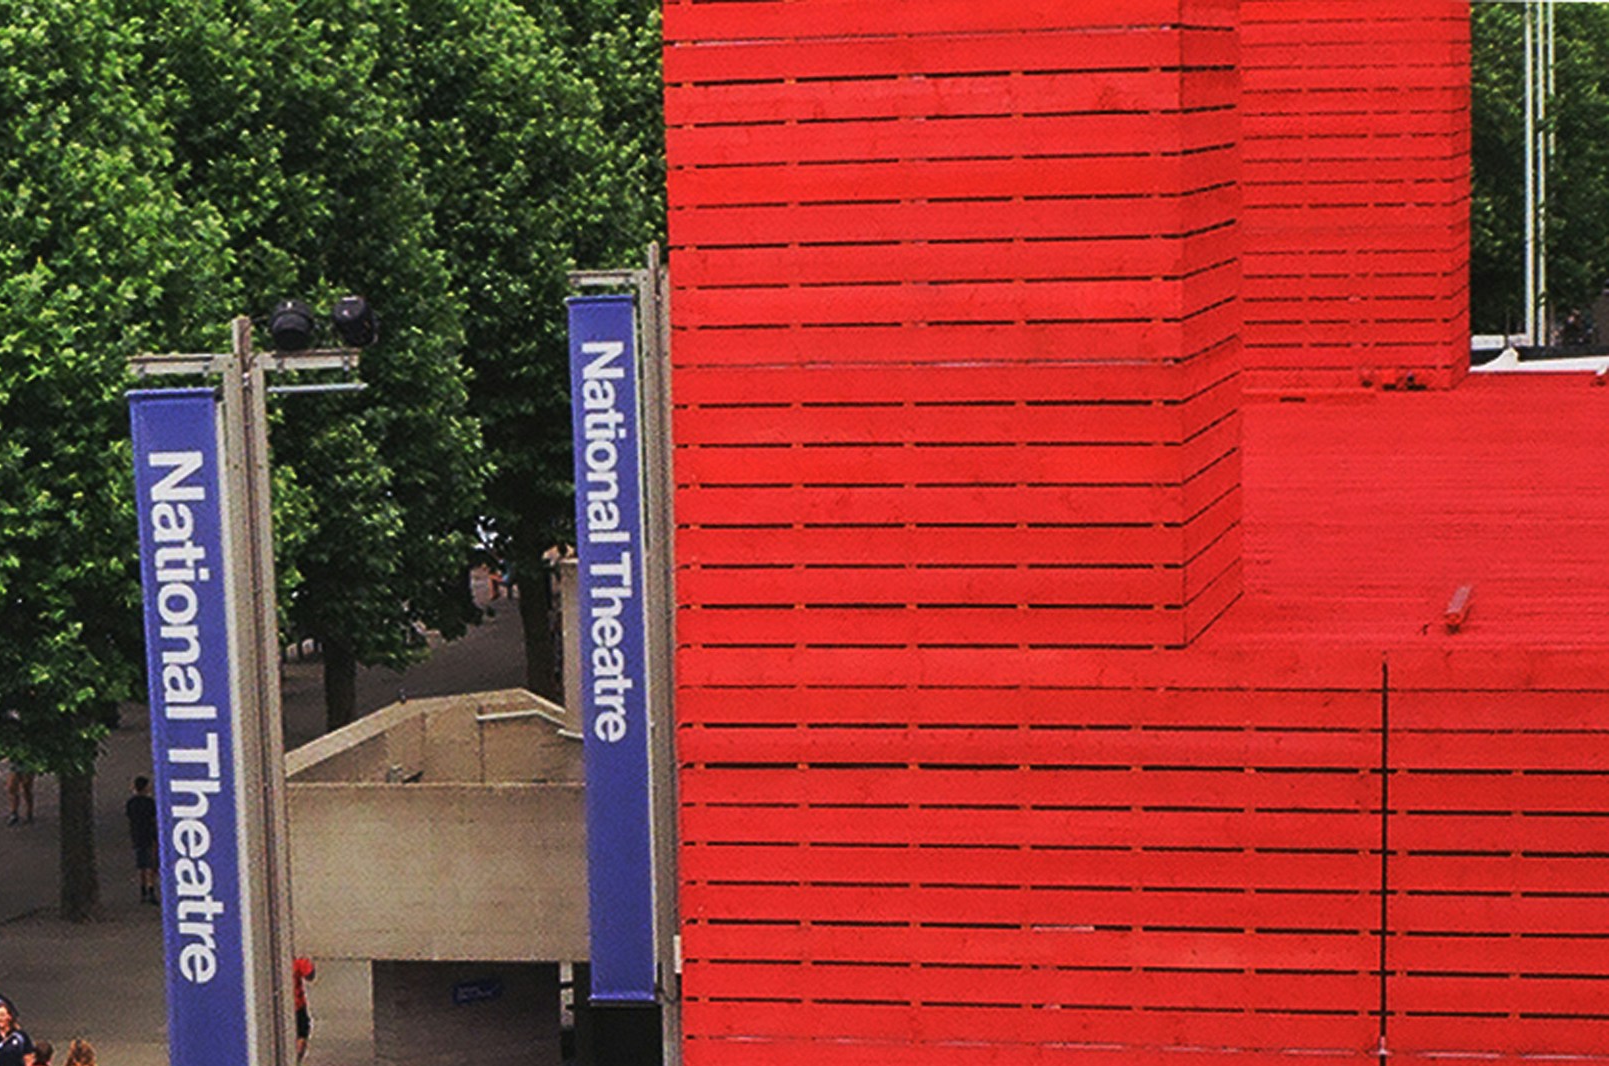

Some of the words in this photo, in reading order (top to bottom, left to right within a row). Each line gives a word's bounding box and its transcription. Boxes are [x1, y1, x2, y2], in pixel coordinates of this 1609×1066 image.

[581, 341, 631, 543] National
[147, 450, 218, 720] National
[589, 551, 633, 742] Theatre
[167, 732, 224, 983] Theatre
